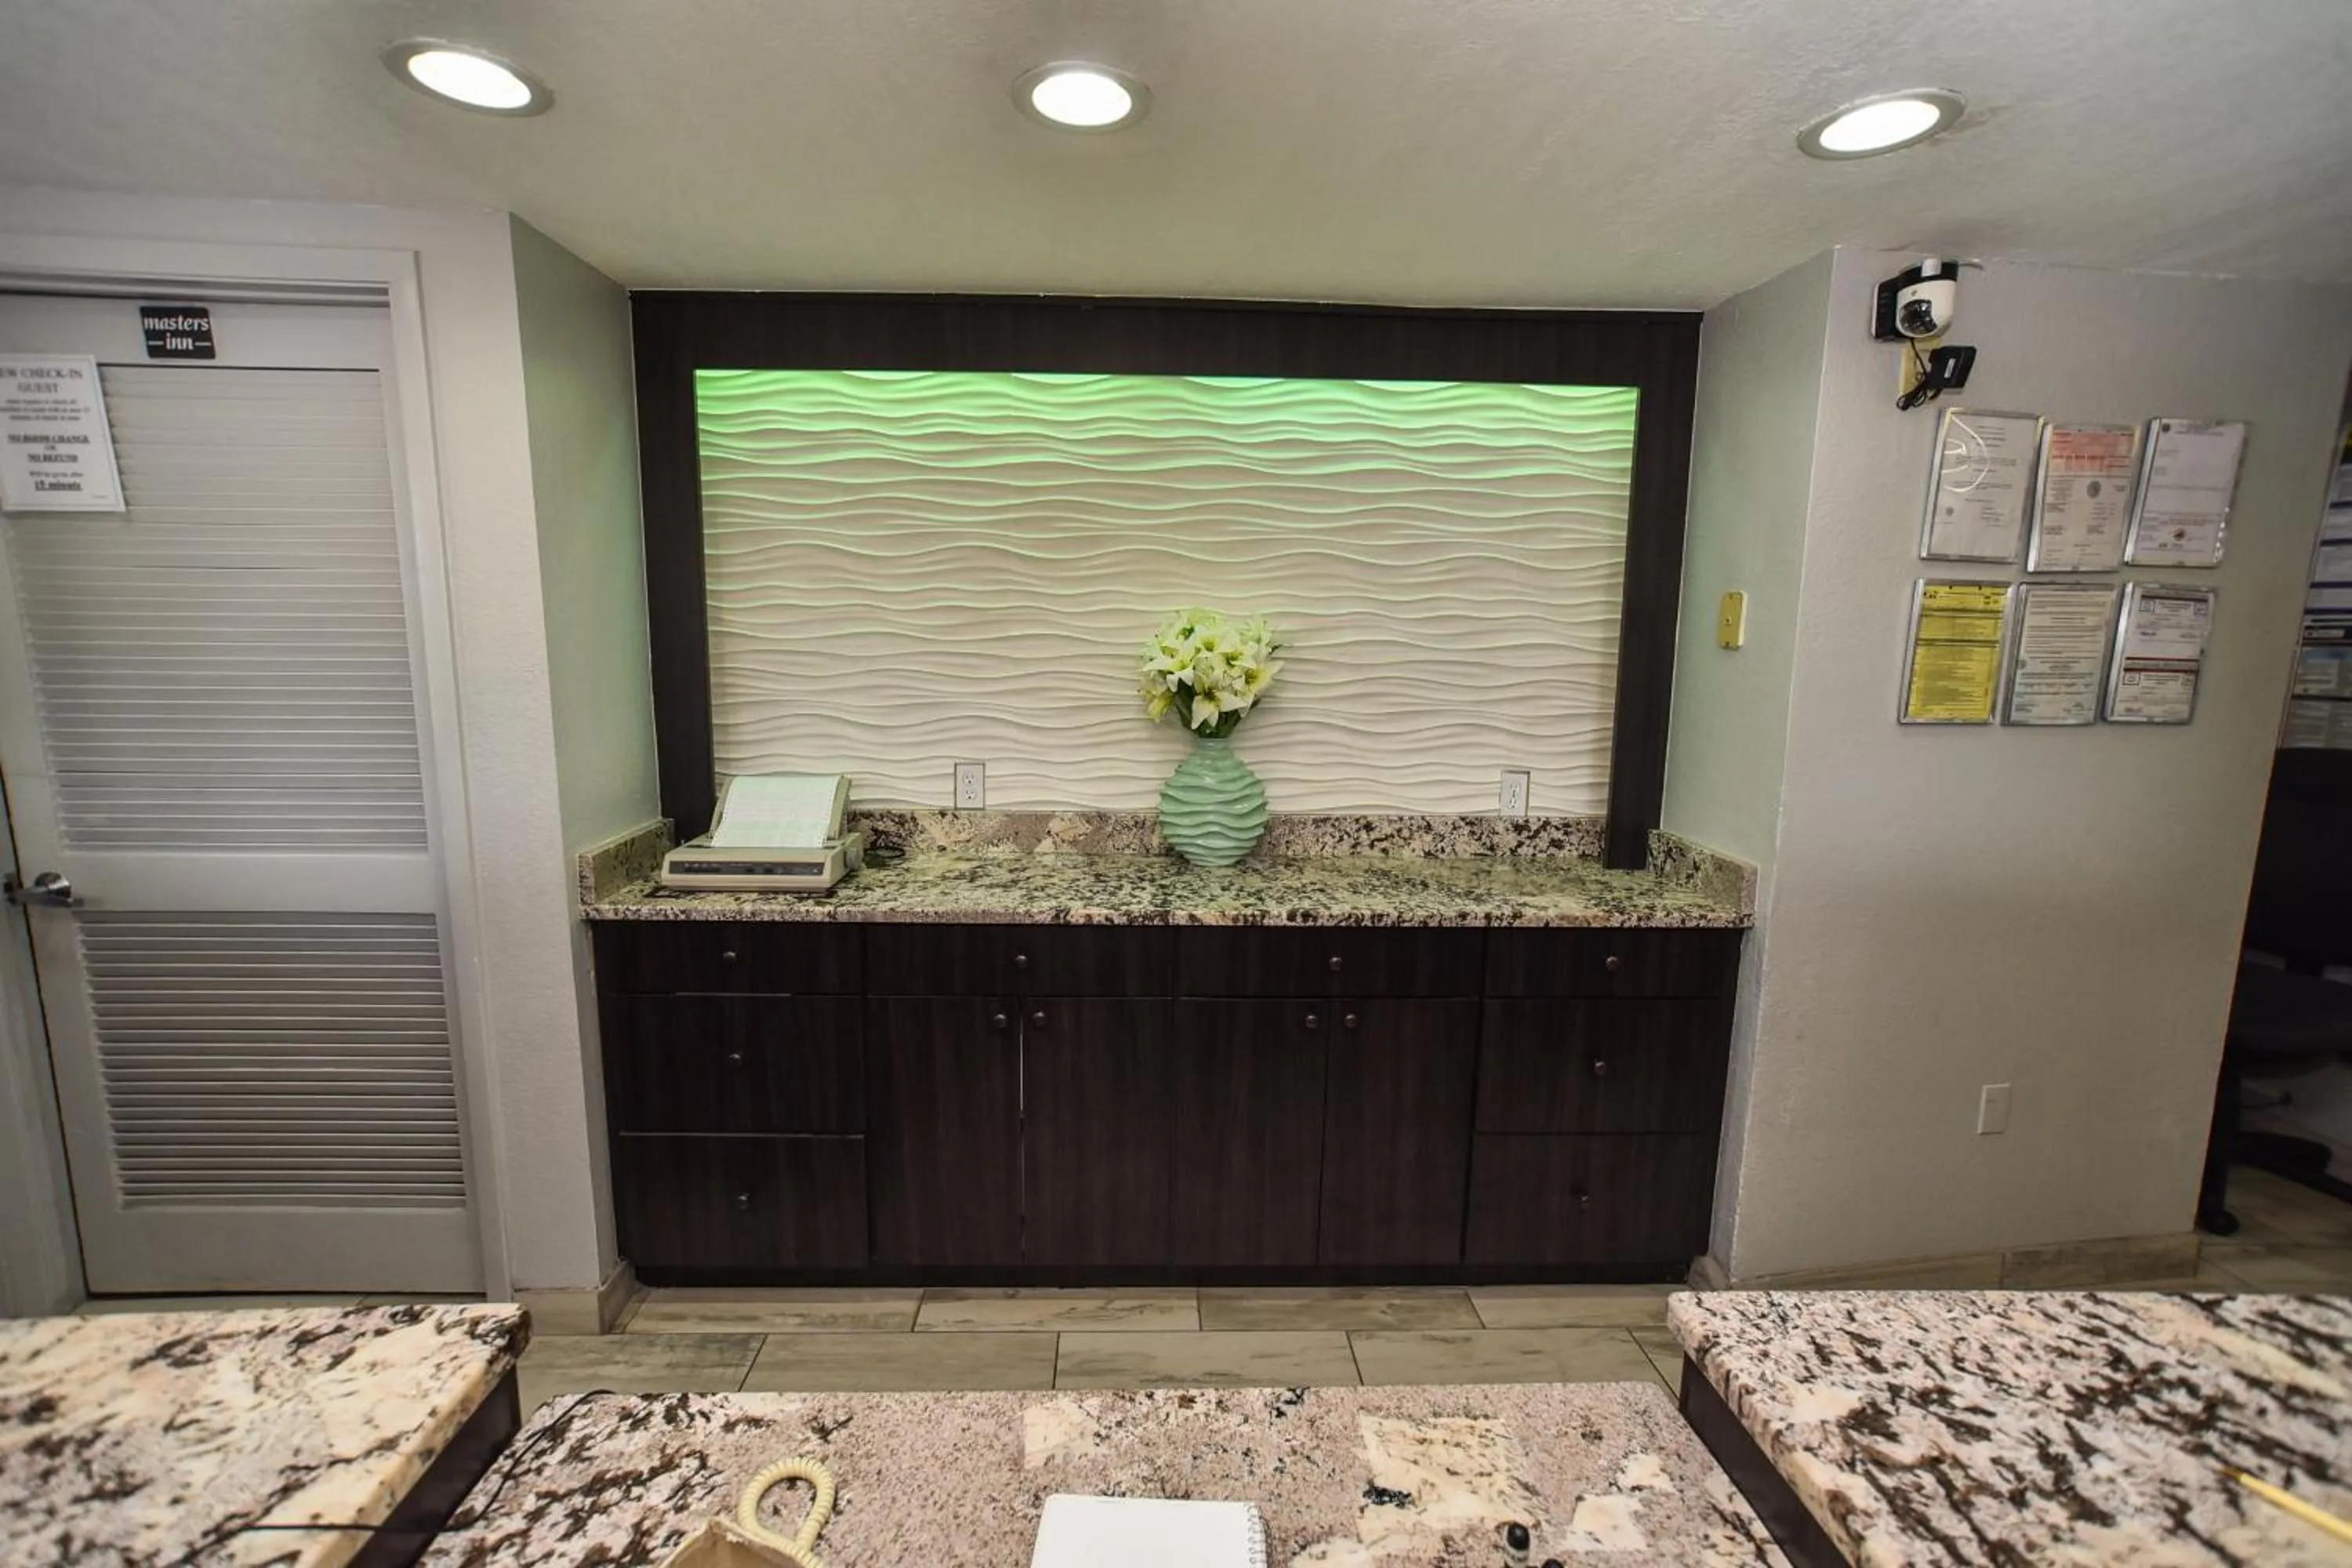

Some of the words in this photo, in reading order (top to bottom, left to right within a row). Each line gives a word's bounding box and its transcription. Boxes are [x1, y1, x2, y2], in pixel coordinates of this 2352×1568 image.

[143, 314, 209, 332] masters
[165, 332, 194, 350] inn
[17, 381, 58, 394] GUEST
